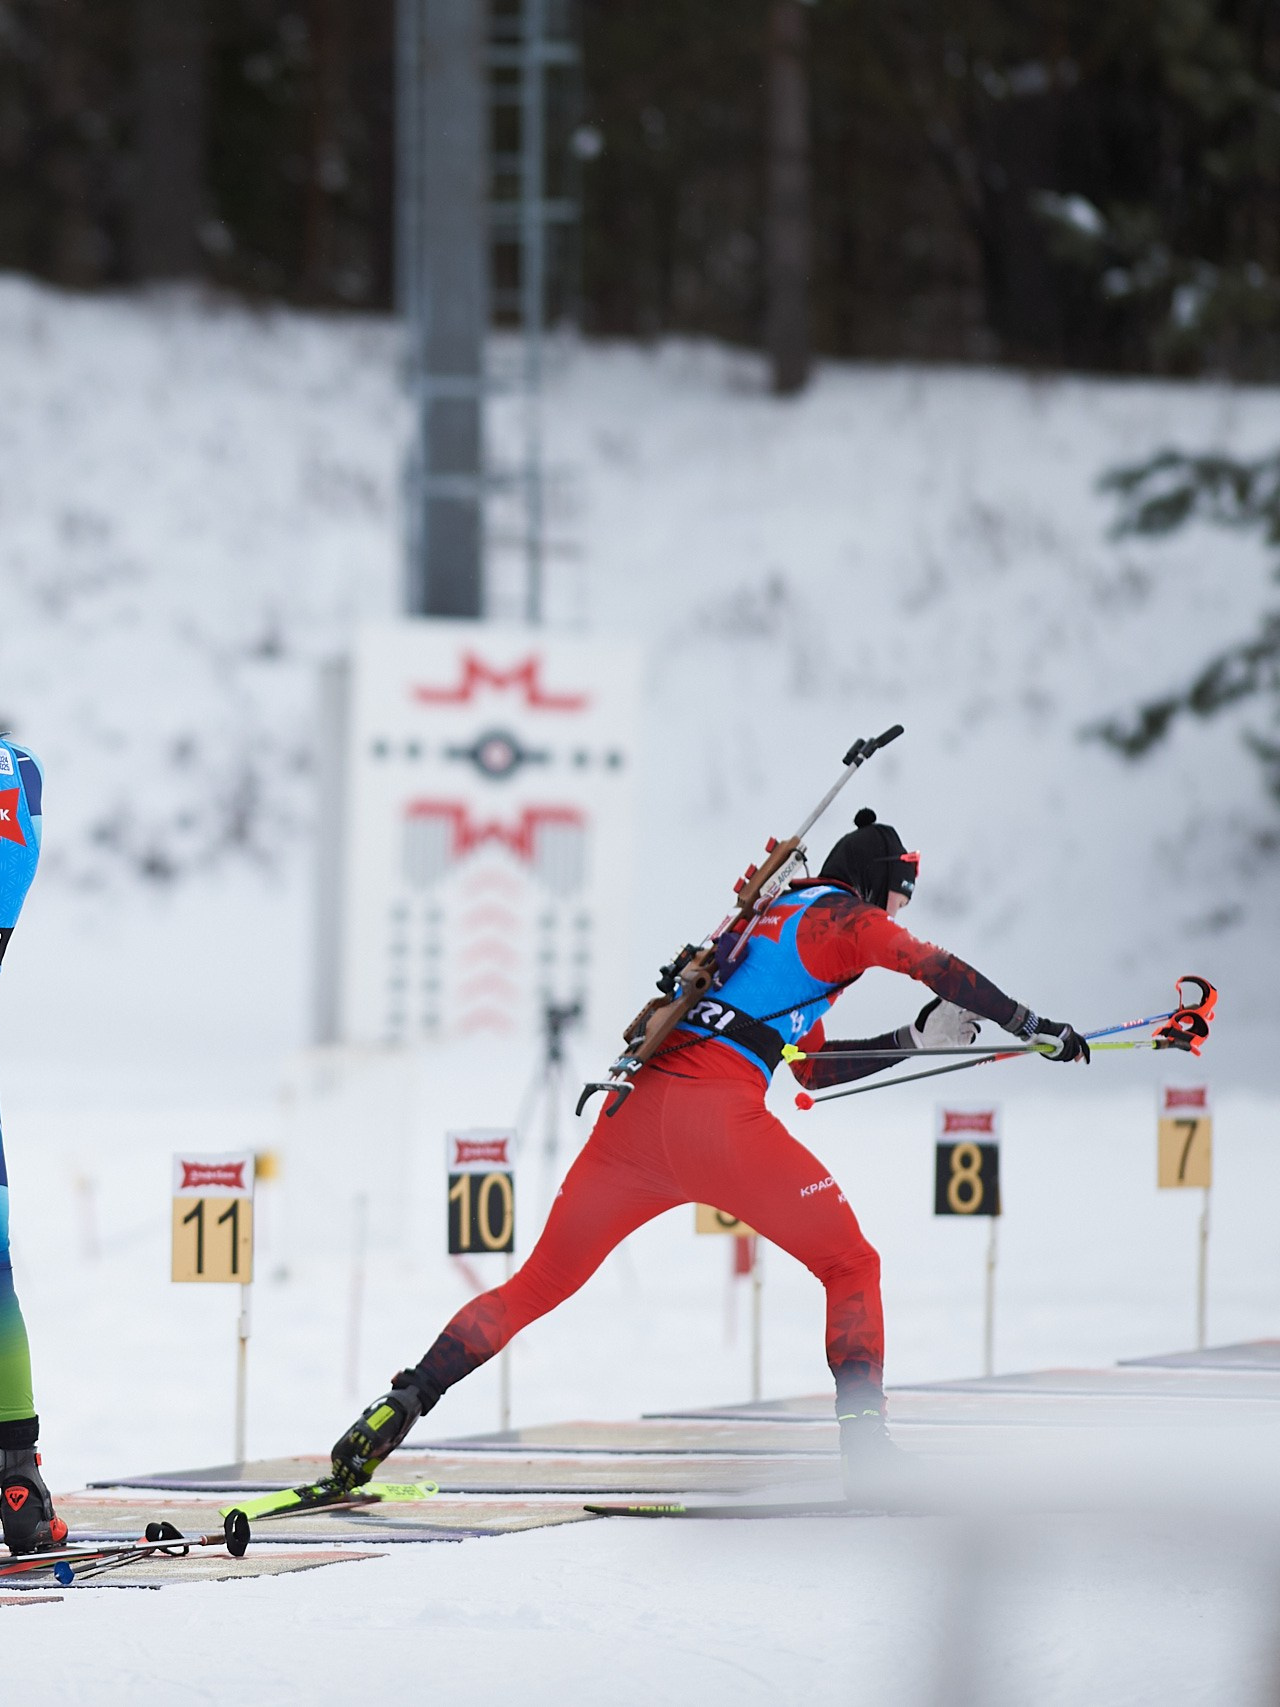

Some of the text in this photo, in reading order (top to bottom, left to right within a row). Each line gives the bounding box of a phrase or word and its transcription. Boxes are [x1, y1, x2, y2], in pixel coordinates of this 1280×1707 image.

[947, 1142, 983, 1214] 8
[1173, 1118, 1198, 1181] 7
[183, 1199, 239, 1274] 11
[449, 1172, 513, 1249] 10
